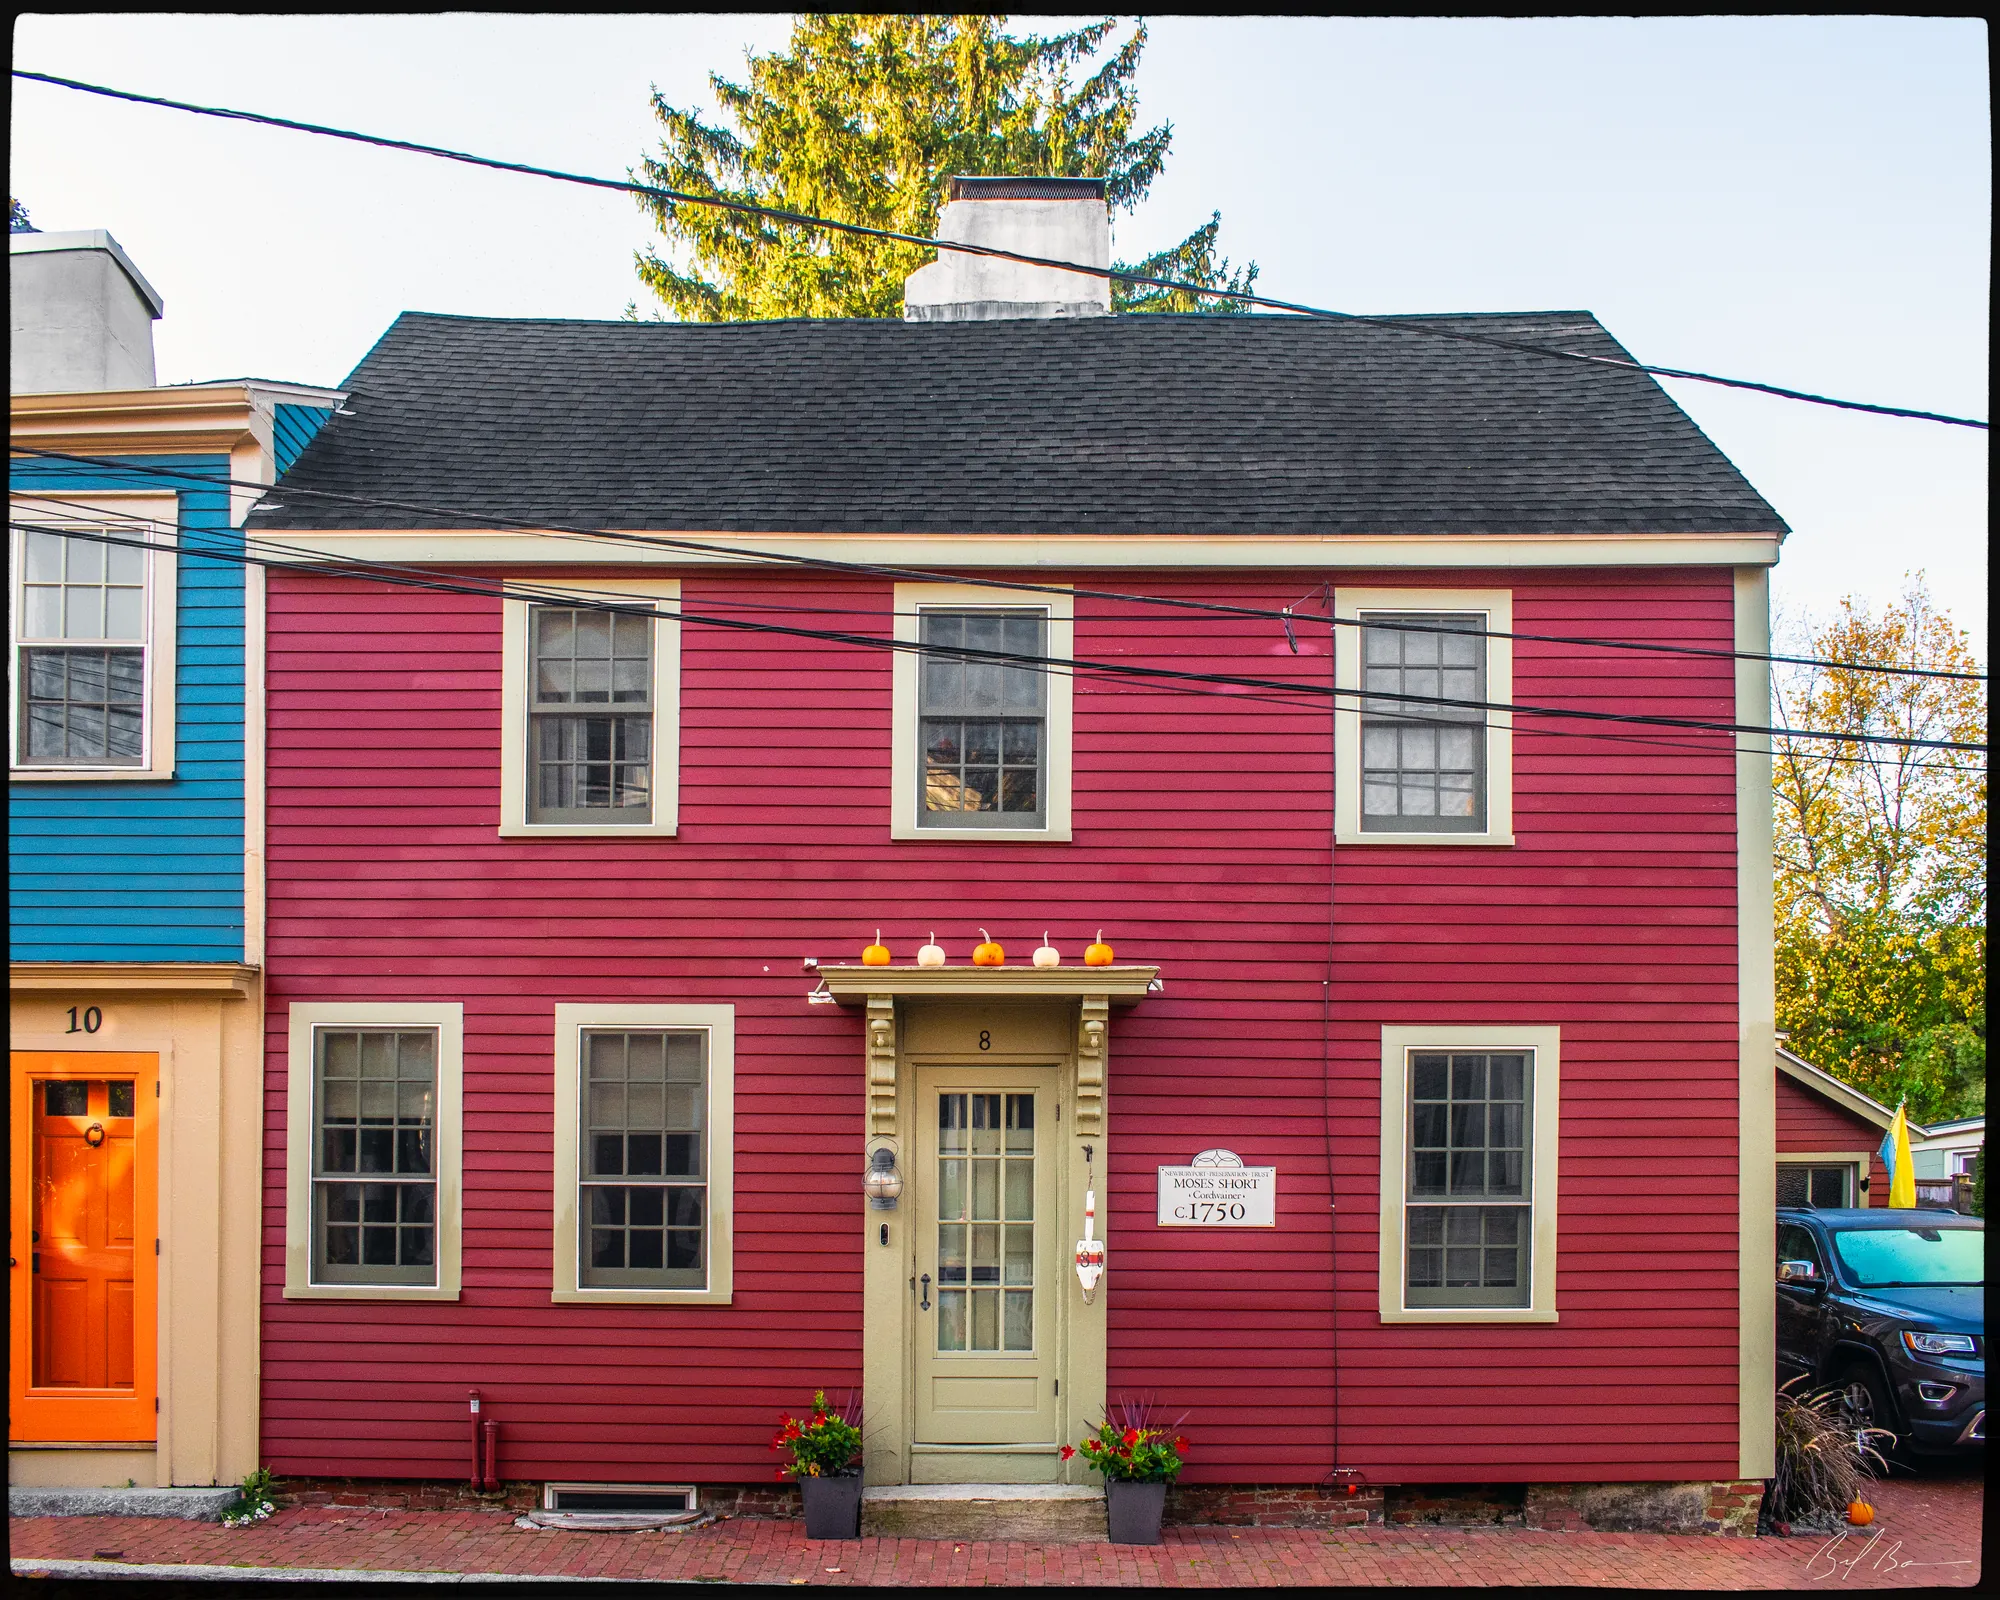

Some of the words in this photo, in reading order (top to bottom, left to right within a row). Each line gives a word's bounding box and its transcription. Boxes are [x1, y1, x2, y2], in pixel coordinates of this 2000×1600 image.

[65, 1006, 102, 1034] 10
[979, 1030, 990, 1050] 8
[1174, 1178, 1214, 1189] MOSES
[1218, 1178, 1260, 1189] SHORT
[1192, 1190, 1241, 1200] Cordwainer
[1080, 1250, 1090, 1268] 8
